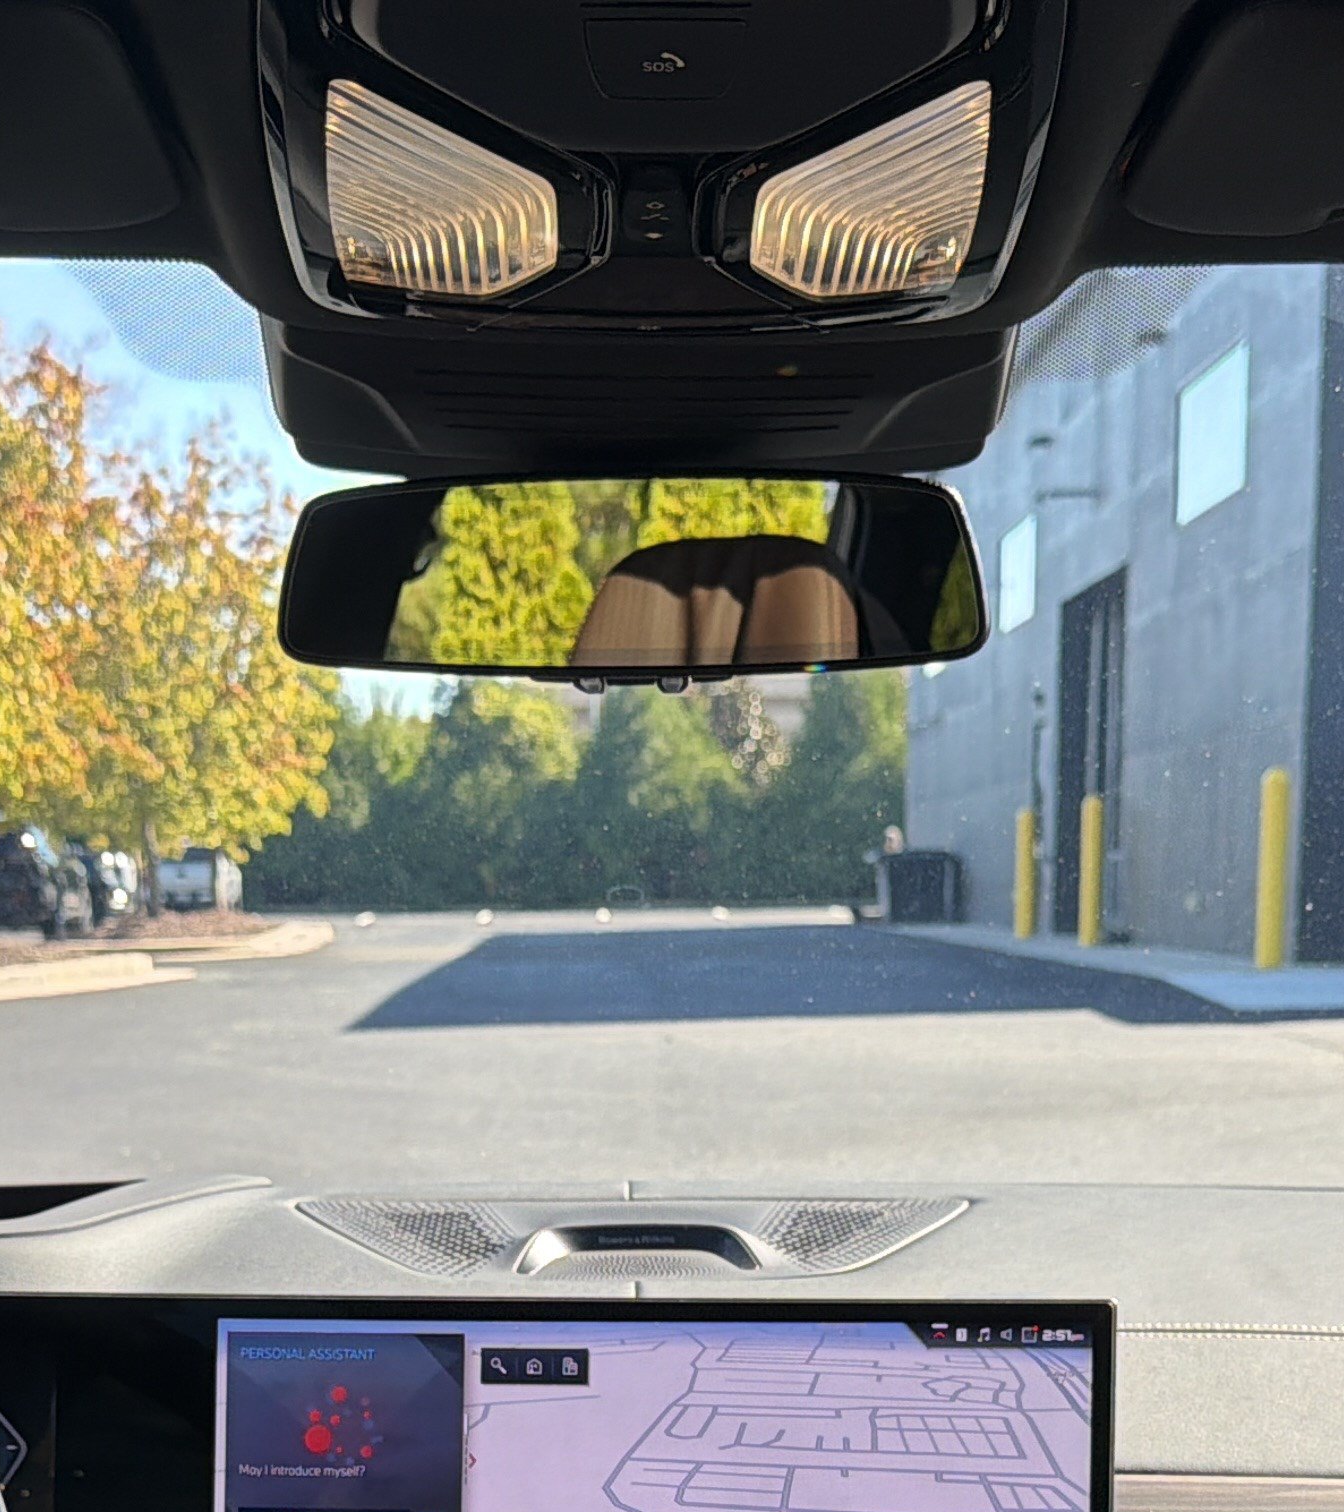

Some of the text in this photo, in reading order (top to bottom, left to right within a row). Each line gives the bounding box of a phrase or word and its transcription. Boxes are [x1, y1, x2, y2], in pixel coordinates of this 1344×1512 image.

[642, 61, 674, 72] SOS
[1042, 1328, 1072, 1342] 2:51
[240, 1347, 376, 1361] PERSONAL ASSISTANT
[239, 1464, 263, 1478] May
[270, 1464, 321, 1476] introduce
[323, 1465, 366, 1478] myself?
